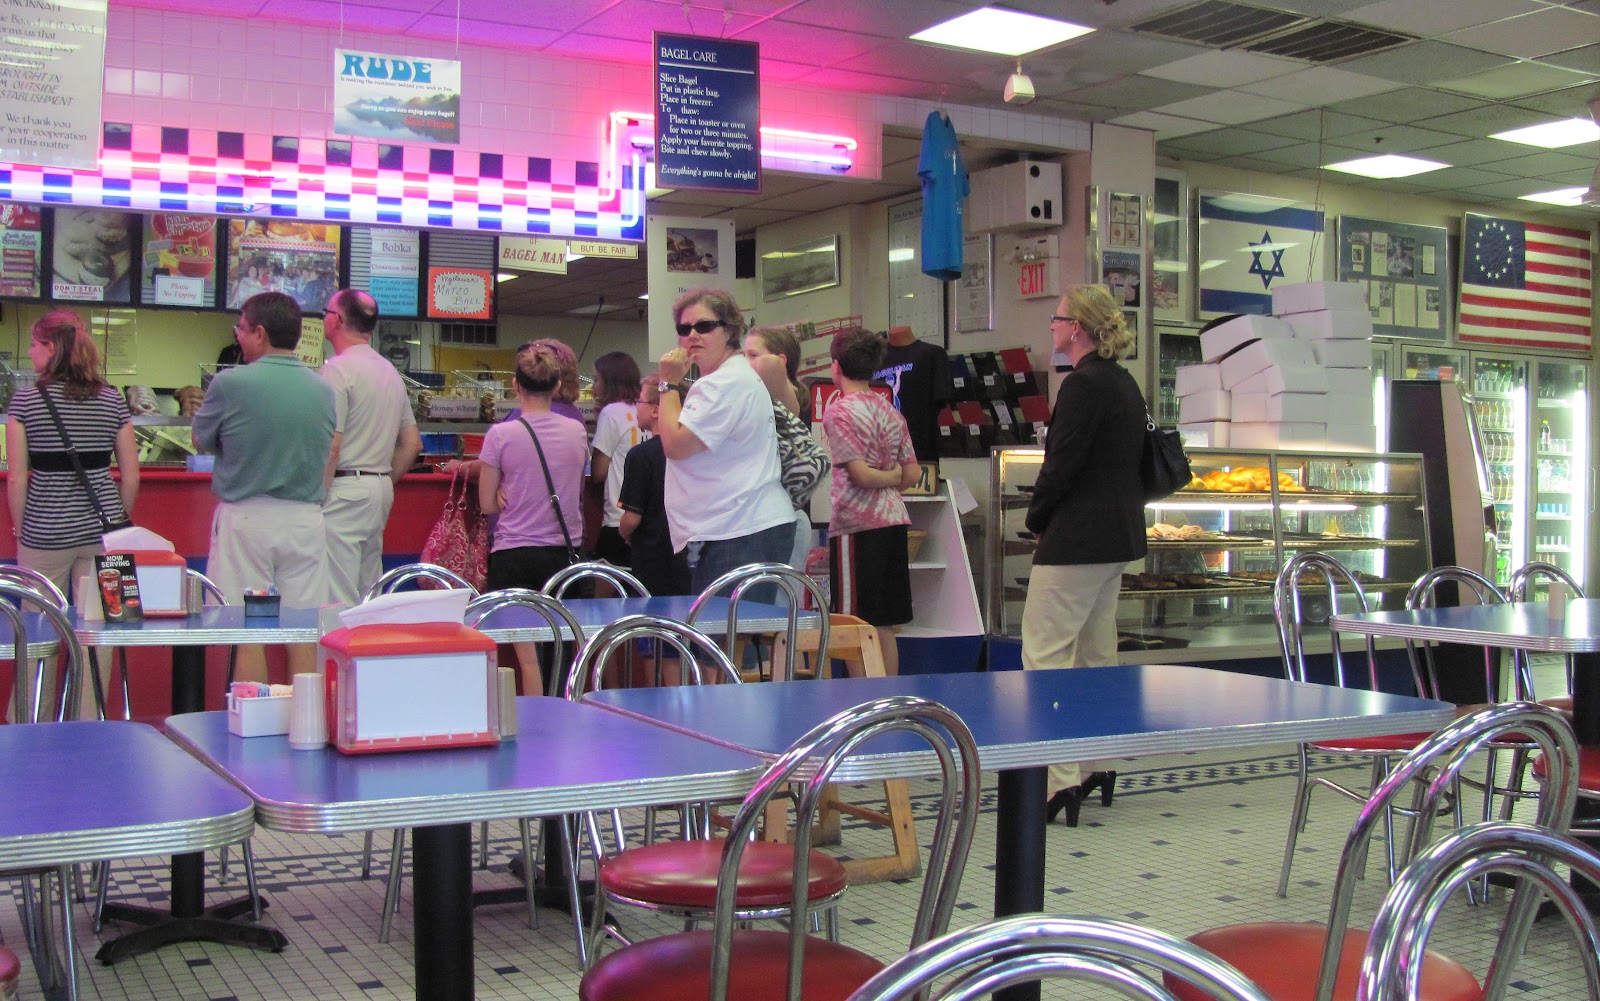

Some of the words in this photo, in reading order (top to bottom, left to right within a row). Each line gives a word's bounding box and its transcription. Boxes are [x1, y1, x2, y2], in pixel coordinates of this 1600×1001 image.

[38, 30, 56, 39] that
[661, 48, 692, 60] BAGEL
[693, 51, 718, 63] CARE
[341, 54, 431, 83] RUDE
[49, 74, 62, 83] IN
[660, 73, 676, 83] Slice
[678, 74, 698, 86] Bagel
[13, 80, 59, 94] OUTSIDE
[660, 83, 673, 93] Put
[675, 84, 681, 94] in
[683, 86, 704, 96] plastic
[706, 87, 720, 98] bag.
[0, 90, 75, 106] STABLISHMENT
[660, 93, 679, 104] Place
[681, 95, 687, 104] in
[690, 96, 713, 107] freezer.
[660, 103, 671, 113] To
[6, 112, 20, 122] We
[22, 115, 51, 126] thank
[53, 121, 71, 129] you
[670, 114, 688, 125] Place
[690, 116, 696, 125] in
[698, 118, 720, 127] toaster
[9, 127, 30, 135] your
[33, 128, 87, 141] cooperation
[670, 125, 679, 134] for
[681, 127, 693, 135] two
[704, 129, 719, 137] three
[722, 130, 749, 139] minutes.
[20, 137, 37, 146] this
[40, 141, 70, 150] matter
[661, 134, 682, 145] Apply
[701, 137, 725, 148] favorite
[727, 141, 753, 150] topping.
[661, 144, 675, 154] Bite
[677, 146, 690, 155] and
[691, 147, 708, 156] chew
[710, 150, 732, 158] slowly.
[661, 165, 701, 176] Everything's
[703, 170, 722, 178] gonna
[724, 169, 732, 178] be
[734, 170, 757, 180] alright!
[382, 243, 411, 252] Bobka
[581, 245, 595, 253] BUT
[598, 245, 608, 253] BE
[611, 246, 626, 254] FAIR
[502, 247, 537, 262] BAGEL
[540, 252, 566, 264] MAN
[1021, 263, 1046, 295] EXIT
[302, 355, 318, 364] MAN
[872, 363, 913, 380] AGELMAN
[102, 560, 130, 568] SERVING
